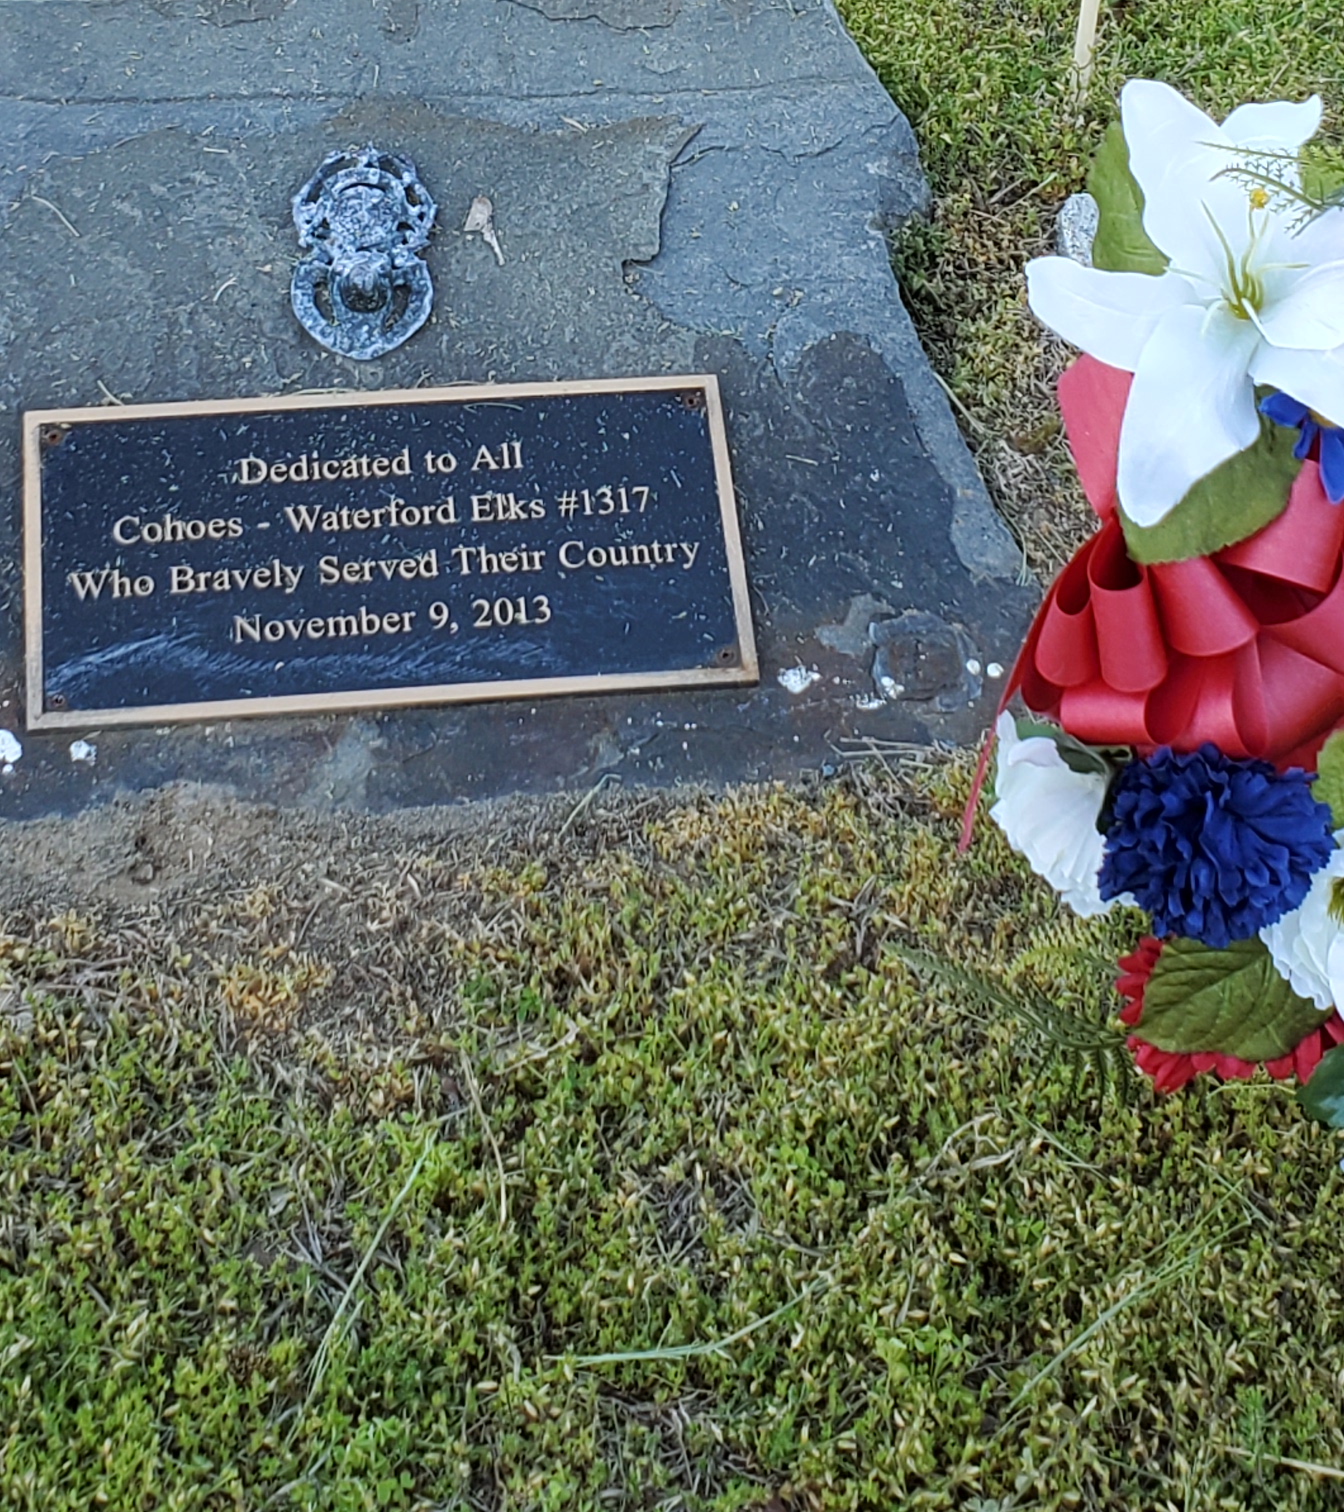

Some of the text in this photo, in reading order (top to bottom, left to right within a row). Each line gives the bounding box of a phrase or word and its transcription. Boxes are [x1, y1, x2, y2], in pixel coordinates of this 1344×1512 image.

[237, 443, 524, 487] Dedicated to All
[112, 513, 244, 546] Cohoes
[284, 497, 457, 534] Waterford
[470, 490, 547, 523] Elks
[557, 485, 652, 518] #1317
[68, 538, 702, 601] Who Bravely Served Their Country
[234, 595, 552, 645] November 9, 2013
